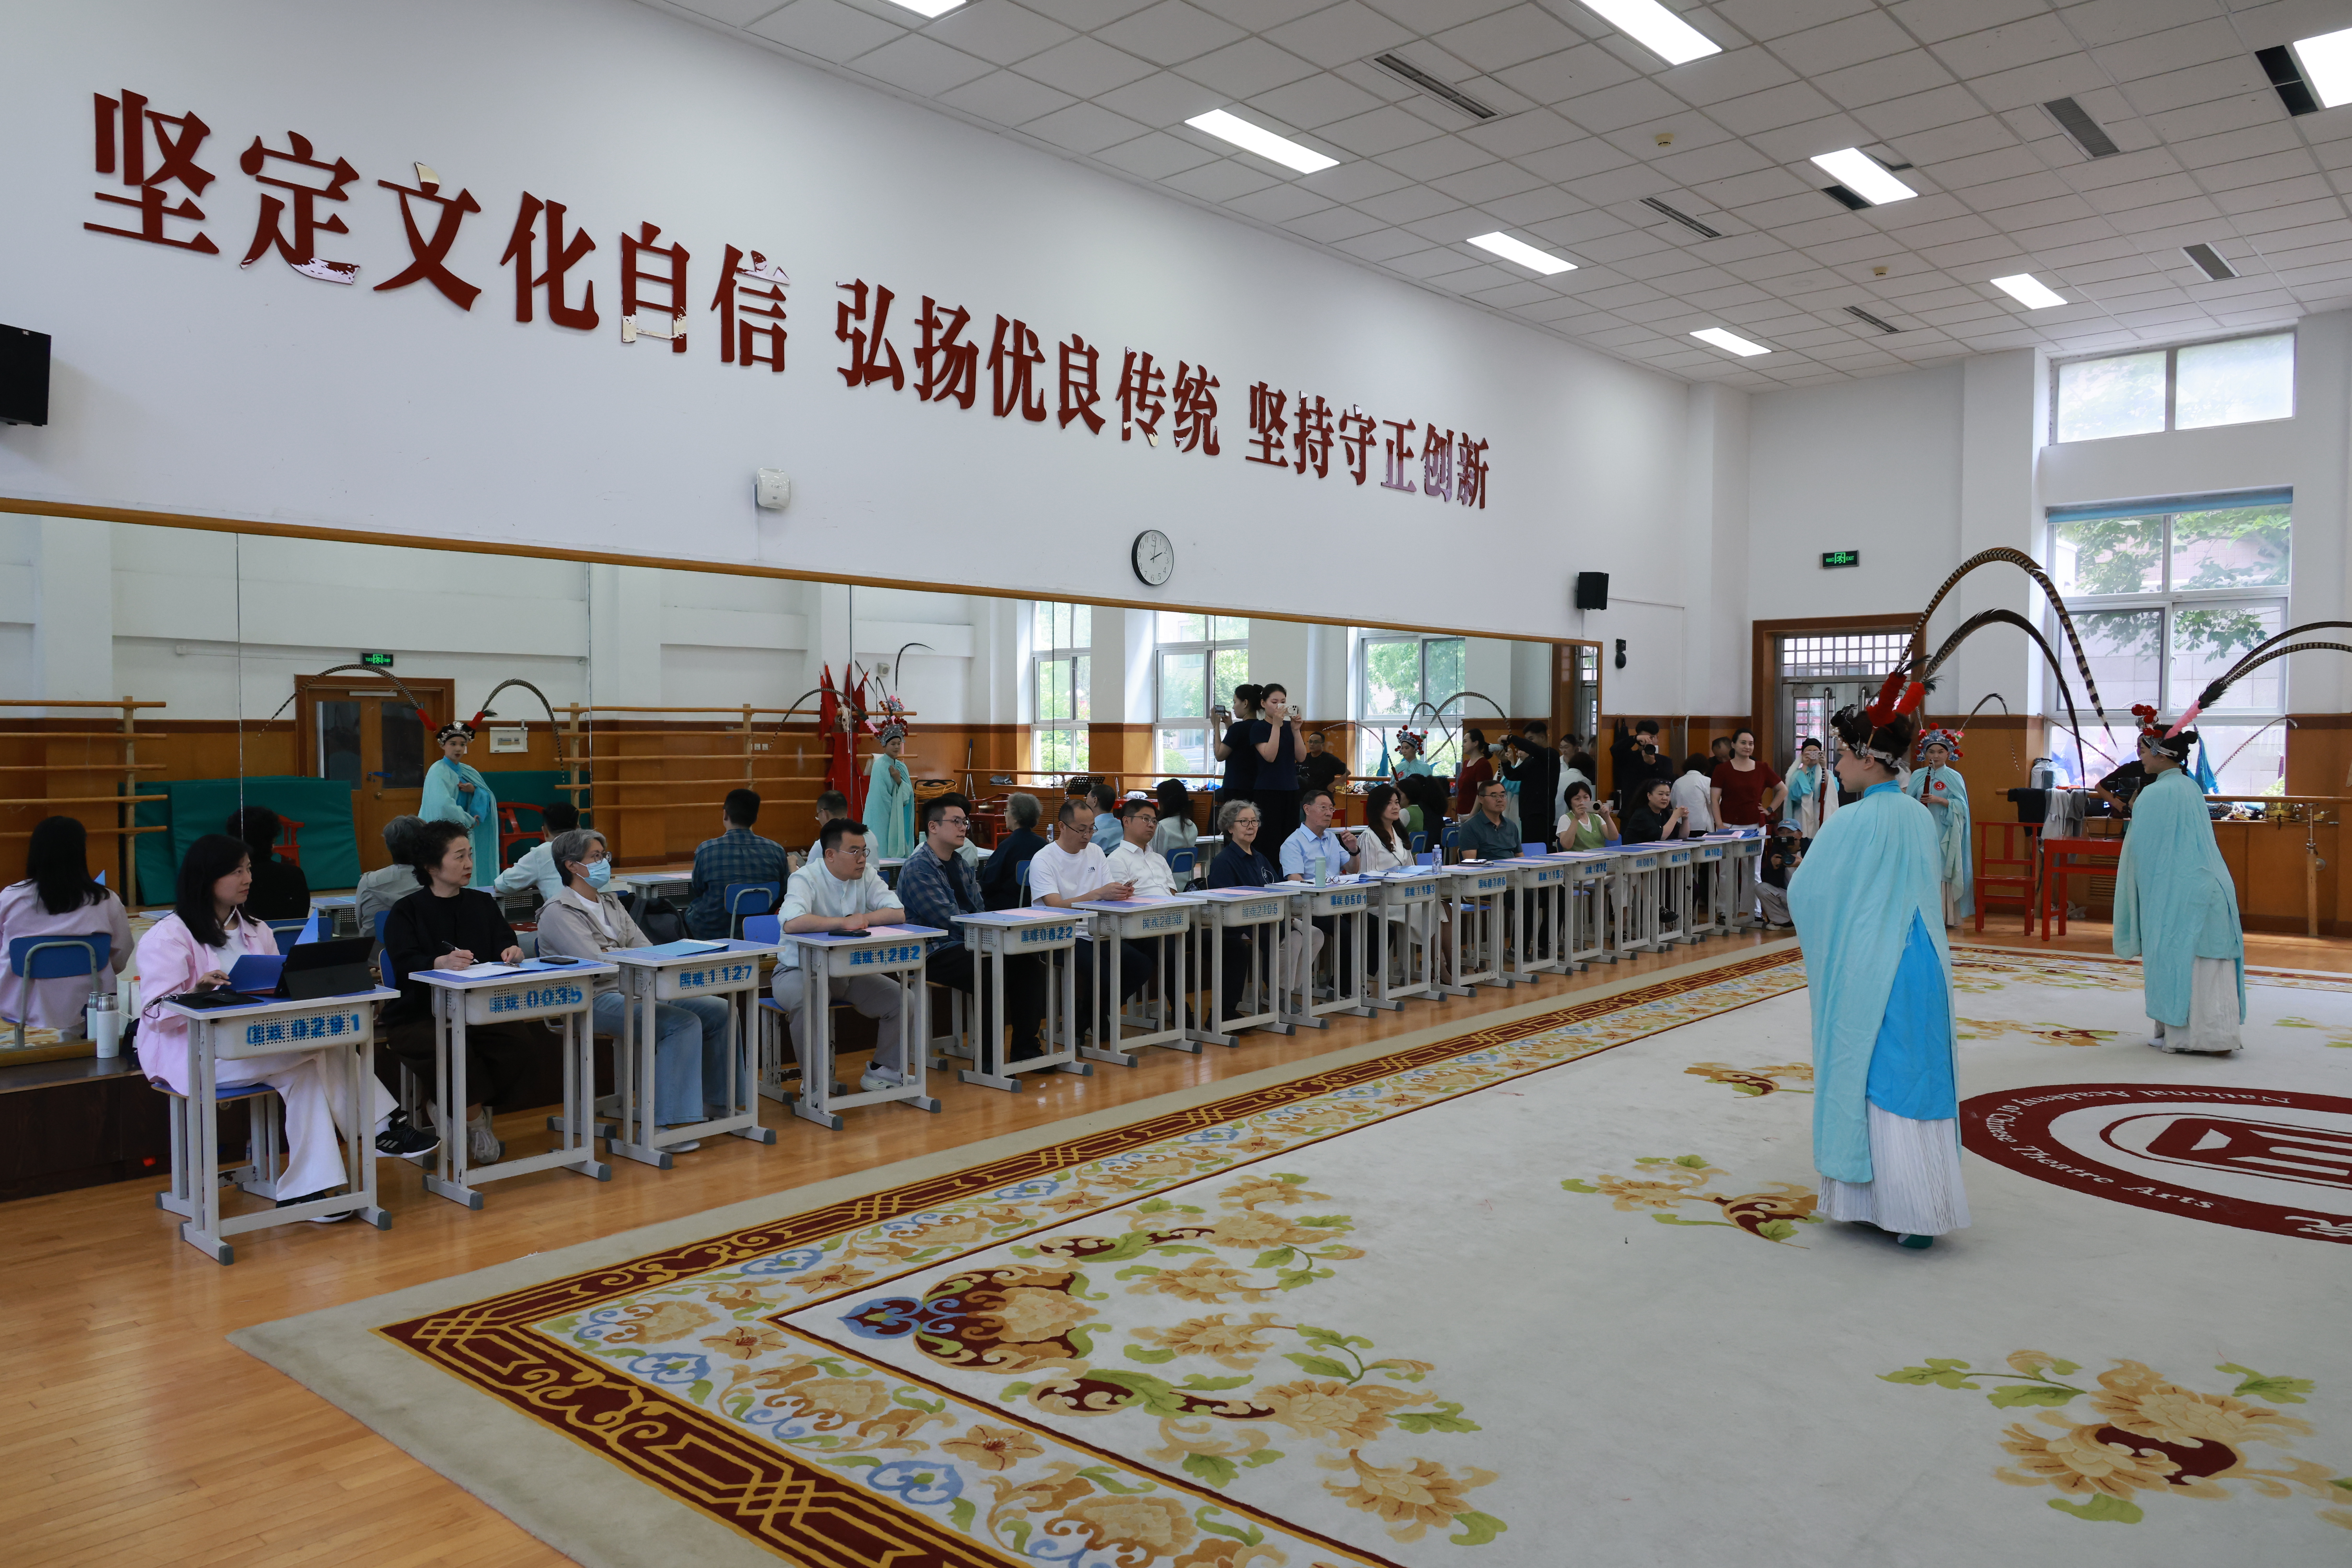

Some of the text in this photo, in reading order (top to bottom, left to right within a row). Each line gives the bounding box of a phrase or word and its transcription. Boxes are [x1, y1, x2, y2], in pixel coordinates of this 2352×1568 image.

[83, 88, 1490, 509] 坚定文化自信 弘扬优良传统 坚持守正创新
[708, 965, 752, 983] 1127
[526, 986, 583, 1008] 0035
[292, 1014, 359, 1039] 0291
[1985, 1090, 2292, 1209] National Academy of Chinese Theatre Arts
